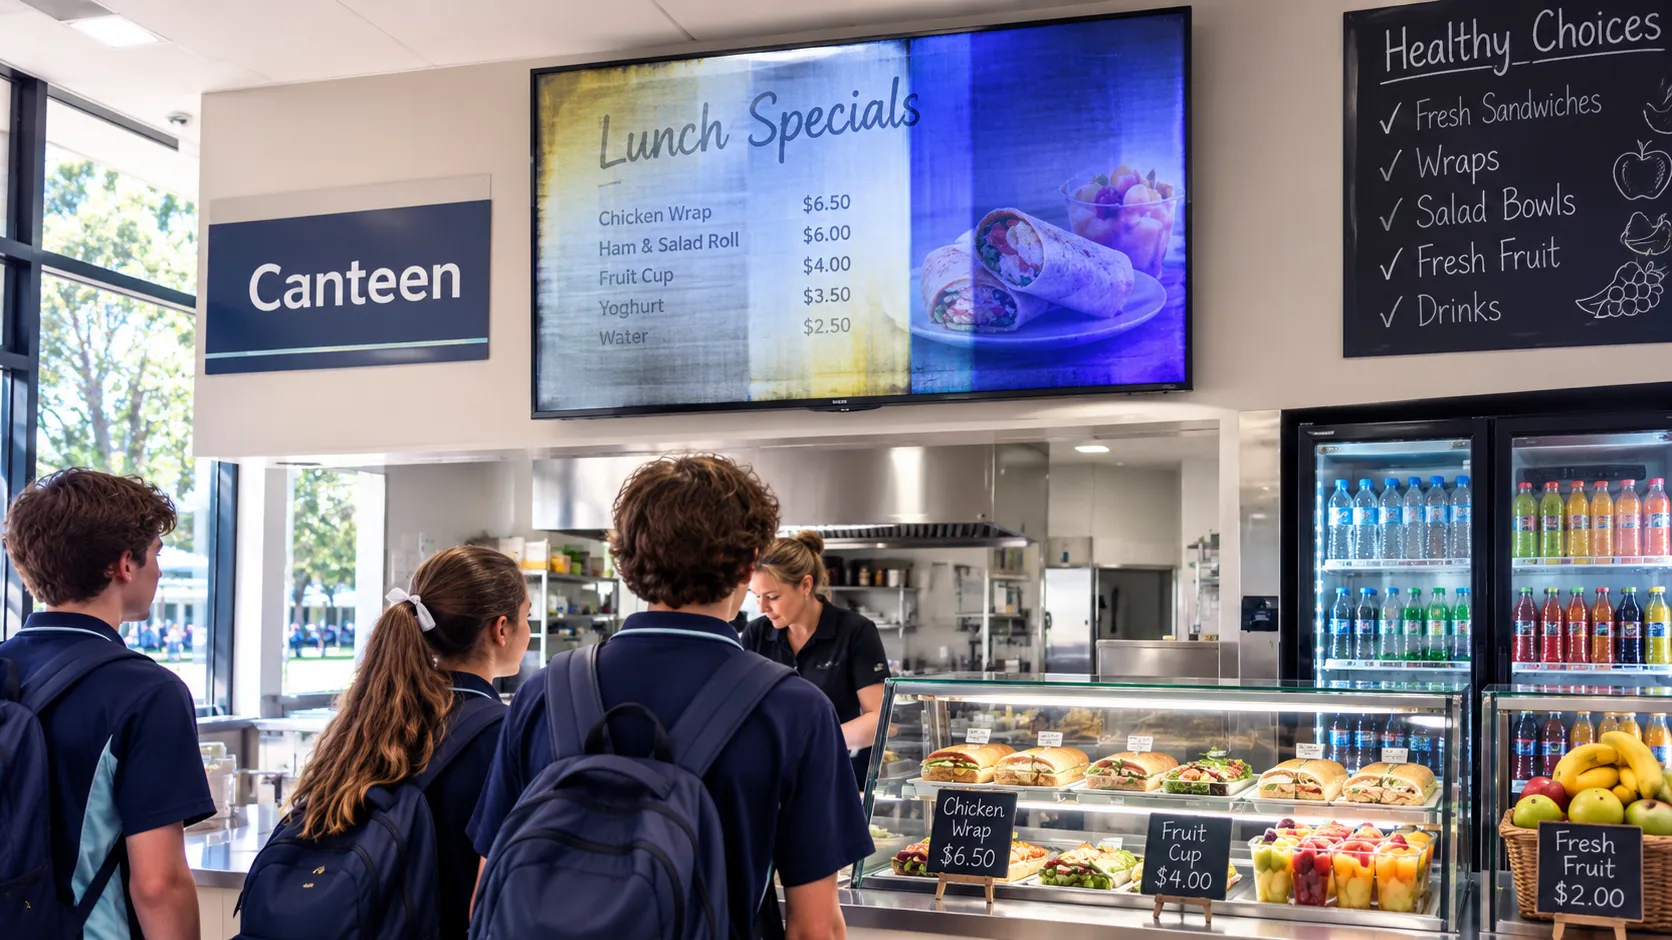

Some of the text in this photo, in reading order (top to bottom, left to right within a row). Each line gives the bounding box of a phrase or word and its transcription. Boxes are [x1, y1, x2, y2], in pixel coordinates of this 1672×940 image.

[1386, 8, 1663, 77] Healthy Choices
[600, 76, 921, 170] Lunch Specials
[1416, 85, 1602, 131] Fresh Sandwiches
[1416, 145, 1500, 185] Wraps
[599, 194, 851, 227] Chicken Wrap $6.50
[1416, 183, 1577, 228] Salad Bowls
[599, 225, 851, 256] Ham & Salad Roll $6.00
[599, 256, 851, 286] Fruit Cup $4.00
[1418, 236, 1561, 278] Fresh Fruit
[248, 260, 461, 312] Canteen
[599, 286, 851, 319] Yoghurt $3.50
[1418, 291, 1502, 327] Drinks
[599, 317, 851, 346] Water $2.50
[943, 796, 1005, 818] Chicken
[952, 819, 992, 844] Wrap
[1162, 820, 1207, 843] Fruit
[1556, 830, 1616, 855] Fresh
[940, 843, 996, 868] $6.50
[1168, 844, 1202, 869] Cup
[1563, 855, 1616, 878] Fruit
[1154, 866, 1212, 890] $4.00
[1554, 880, 1625, 908] $2.00
